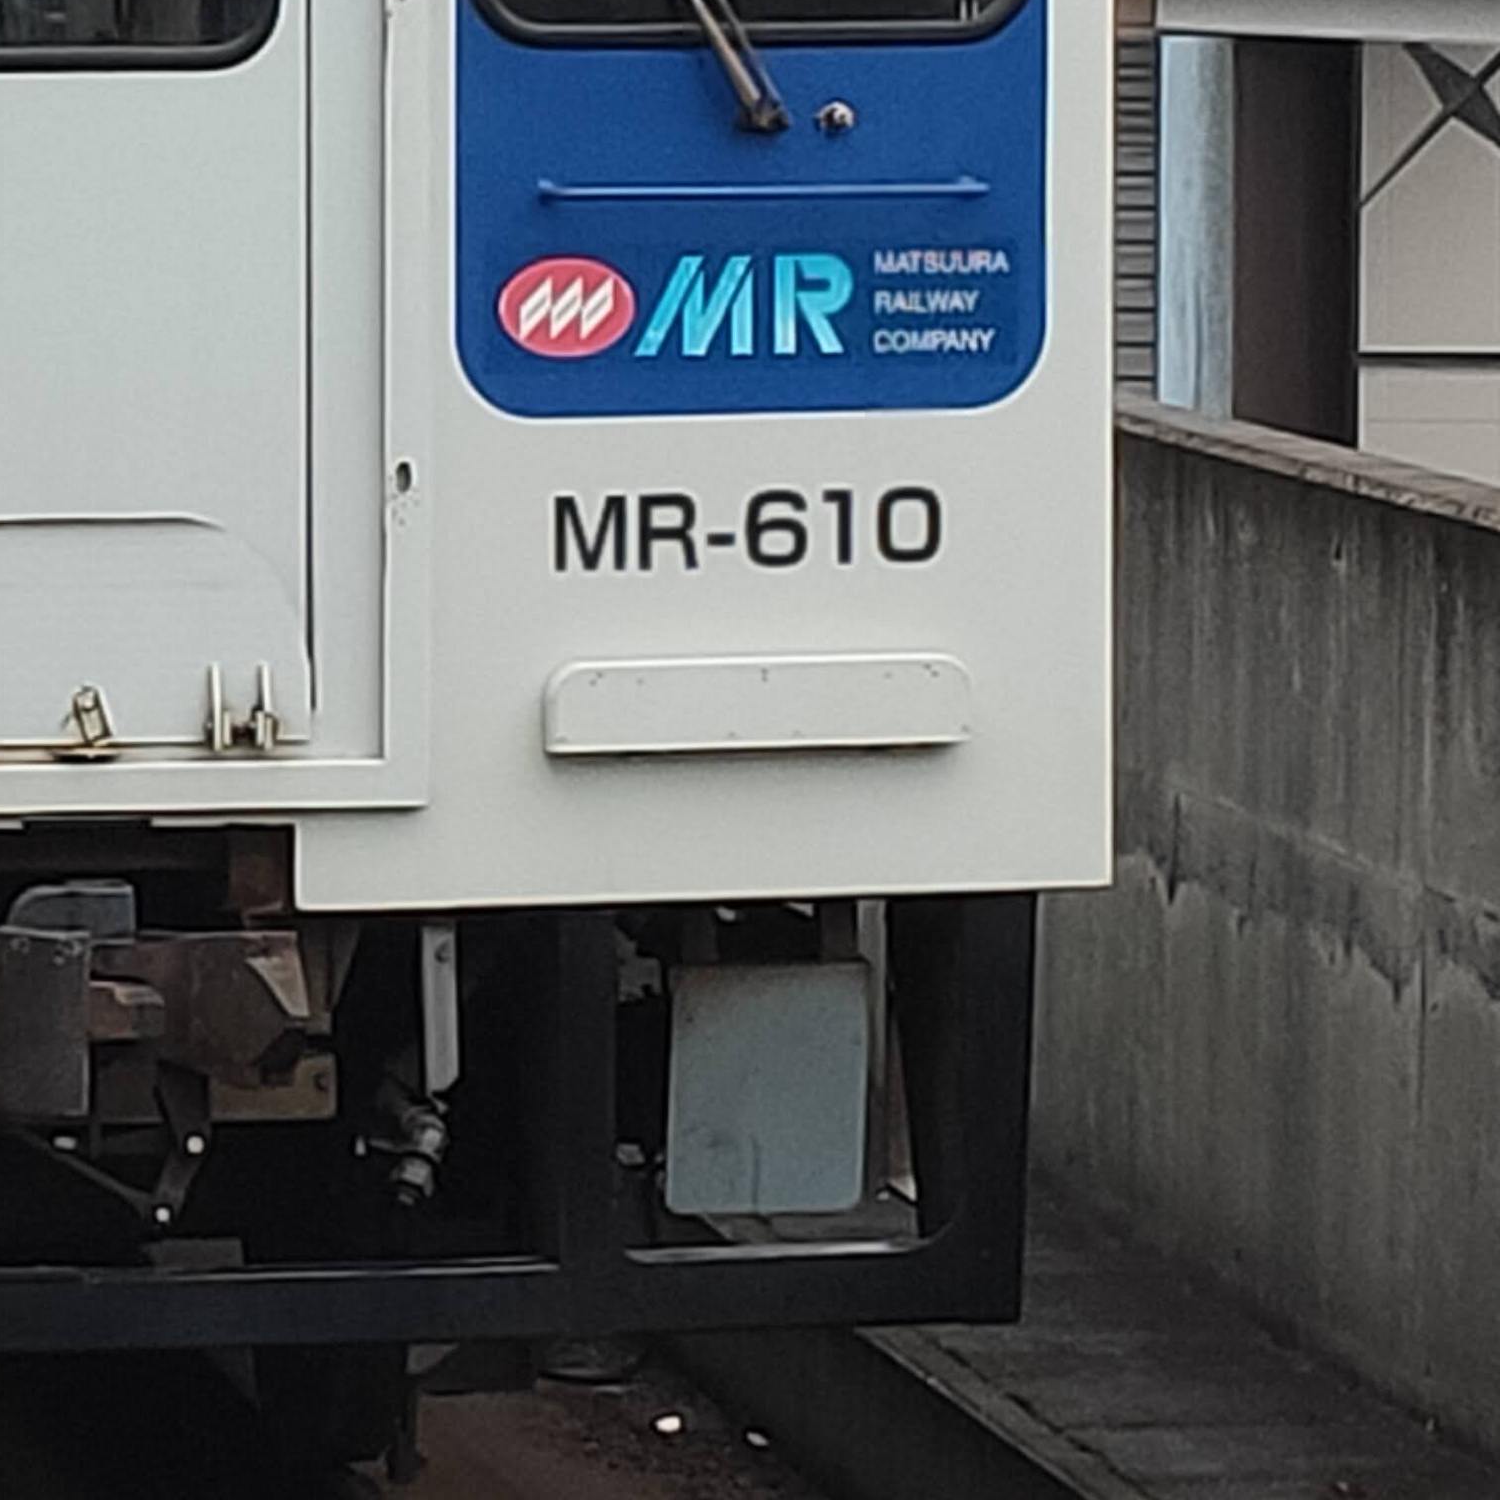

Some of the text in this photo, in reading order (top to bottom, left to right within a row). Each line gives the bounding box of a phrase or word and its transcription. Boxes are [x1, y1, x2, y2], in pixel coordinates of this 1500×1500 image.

[874, 249, 1010, 274] MATSUURA
[635, 252, 854, 357] MR
[874, 290, 979, 315] RAILWAY
[874, 328, 995, 354] COMPANY
[553, 486, 942, 571] MR-610
